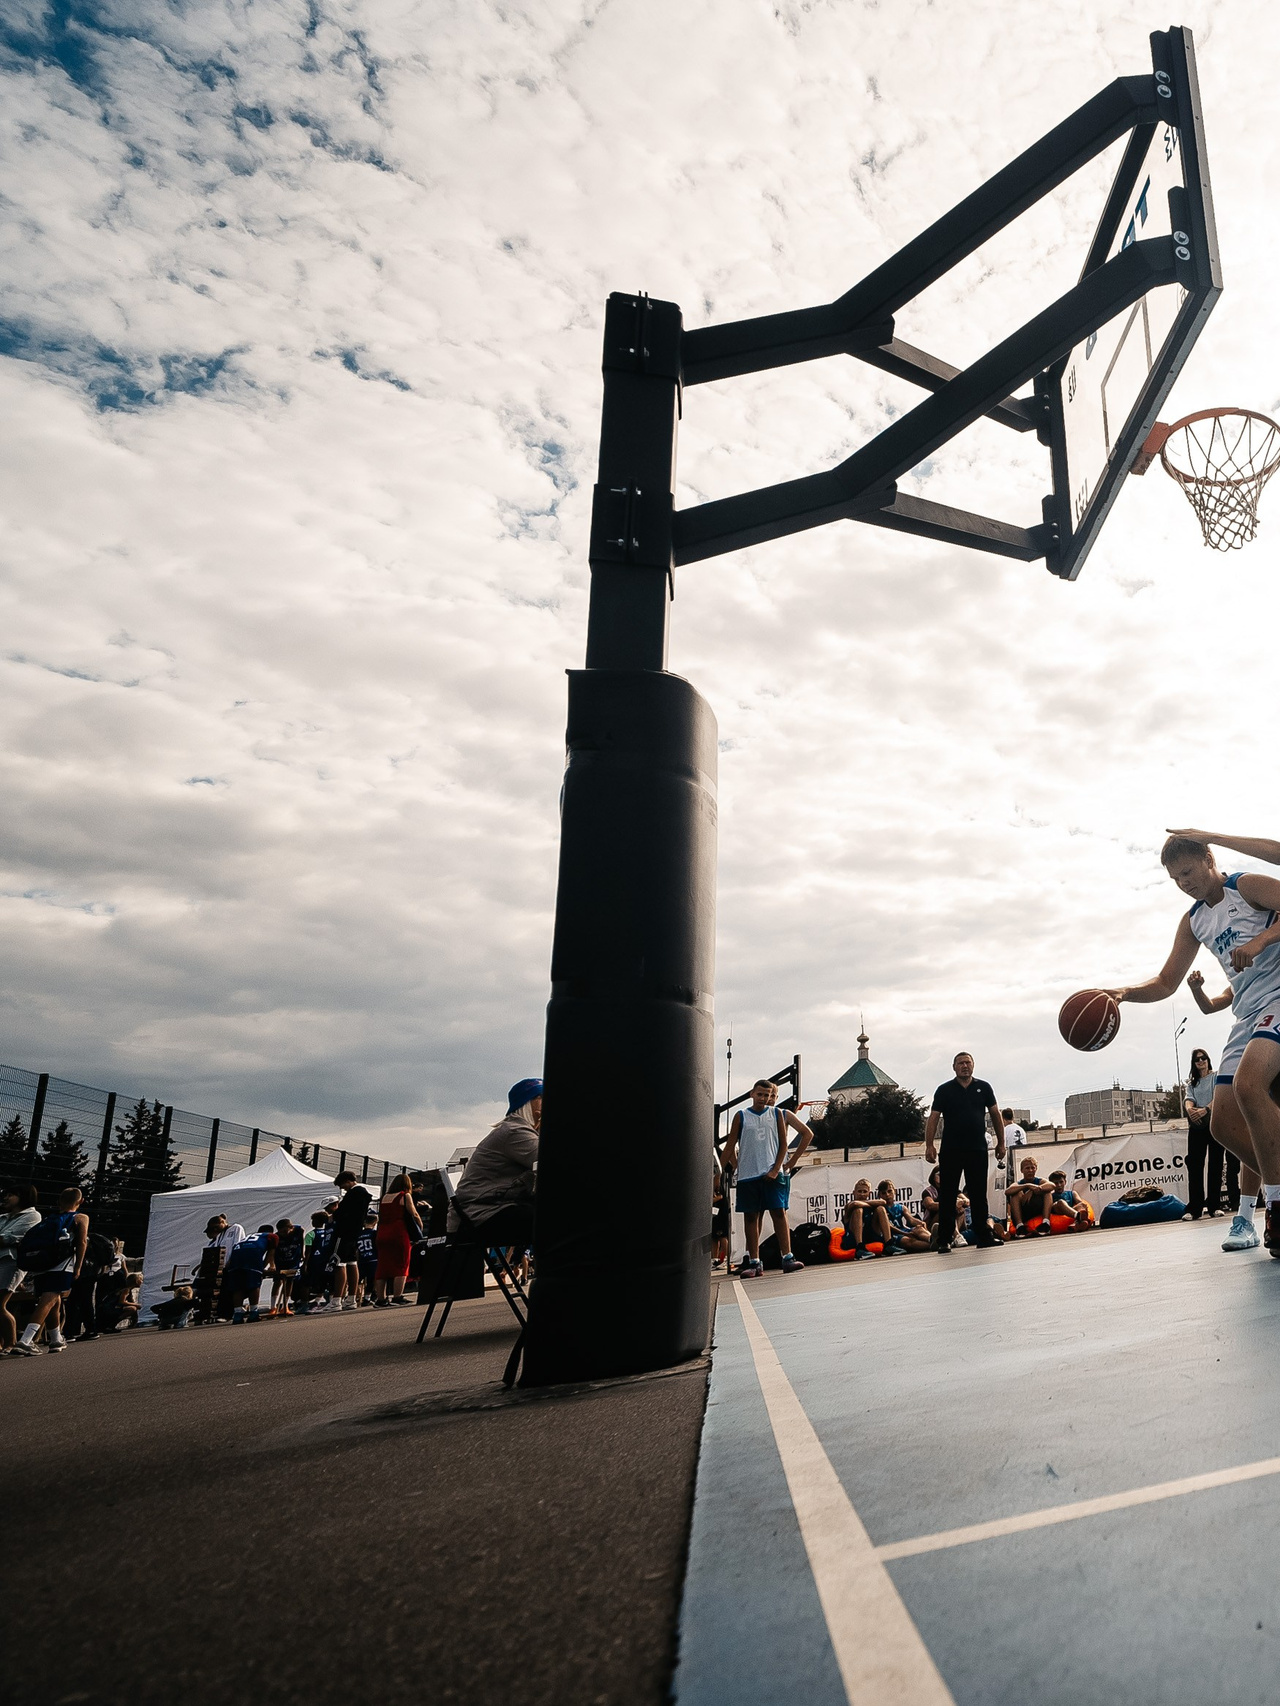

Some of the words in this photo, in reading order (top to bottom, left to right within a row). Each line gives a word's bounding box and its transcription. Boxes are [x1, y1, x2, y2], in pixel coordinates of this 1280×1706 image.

[1089, 1179, 1136, 1192] магазин
[1139, 1173, 1184, 1187] техники
[357, 1239, 373, 1252] 20
